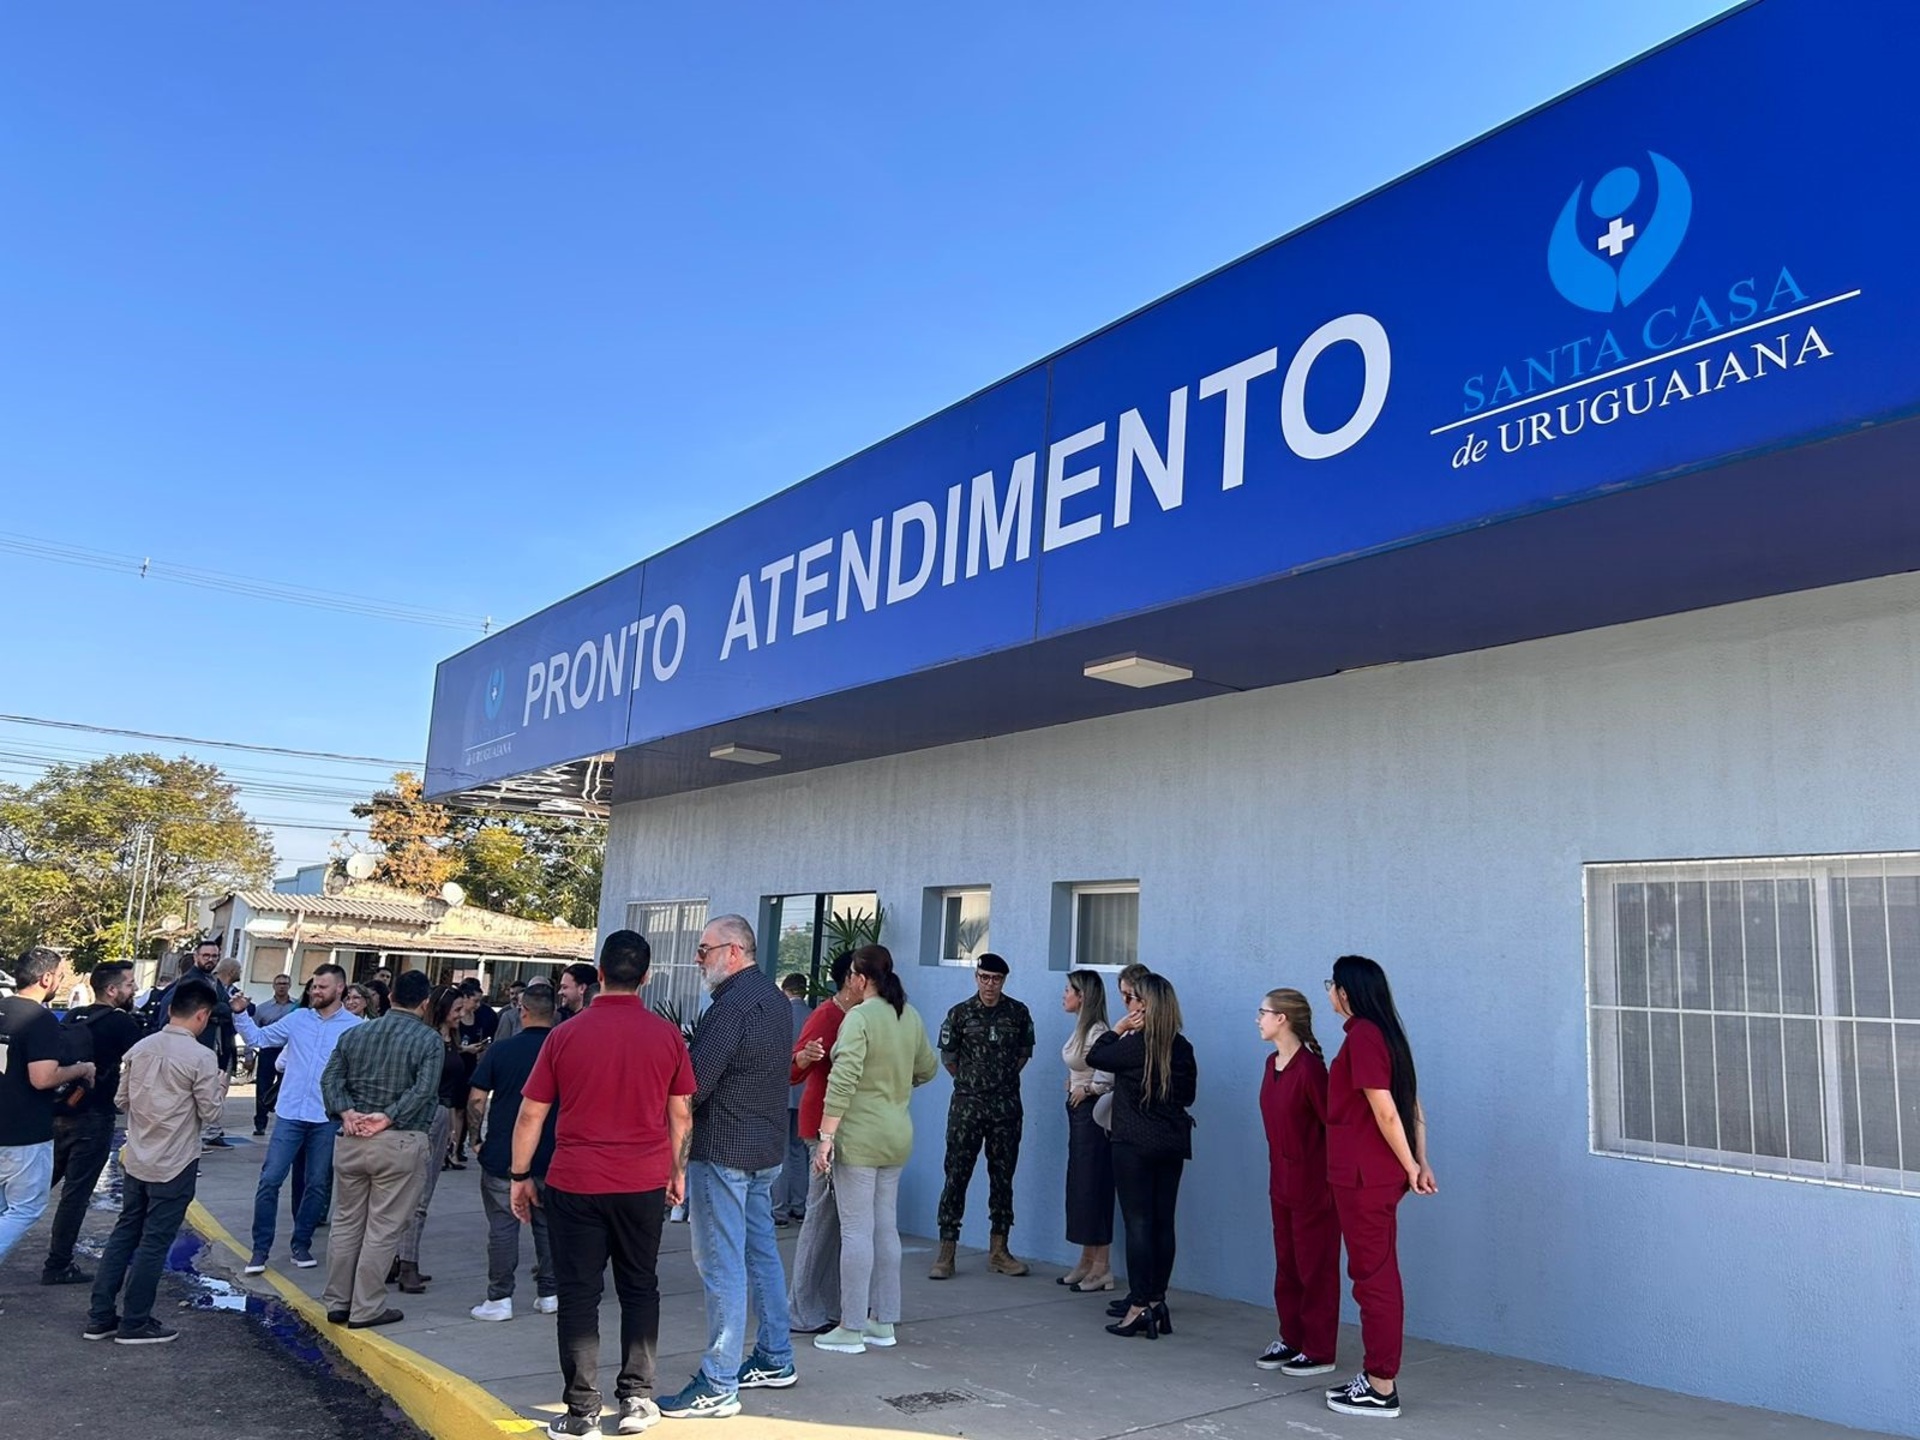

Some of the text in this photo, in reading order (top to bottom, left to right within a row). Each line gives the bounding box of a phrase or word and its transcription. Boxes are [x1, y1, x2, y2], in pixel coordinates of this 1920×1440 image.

[1452, 326, 1834, 469] de URUGUAIANA
[1463, 266, 1809, 414] SANTA CASA
[524, 313, 1391, 727] PRONTO ATENDIMENTO
